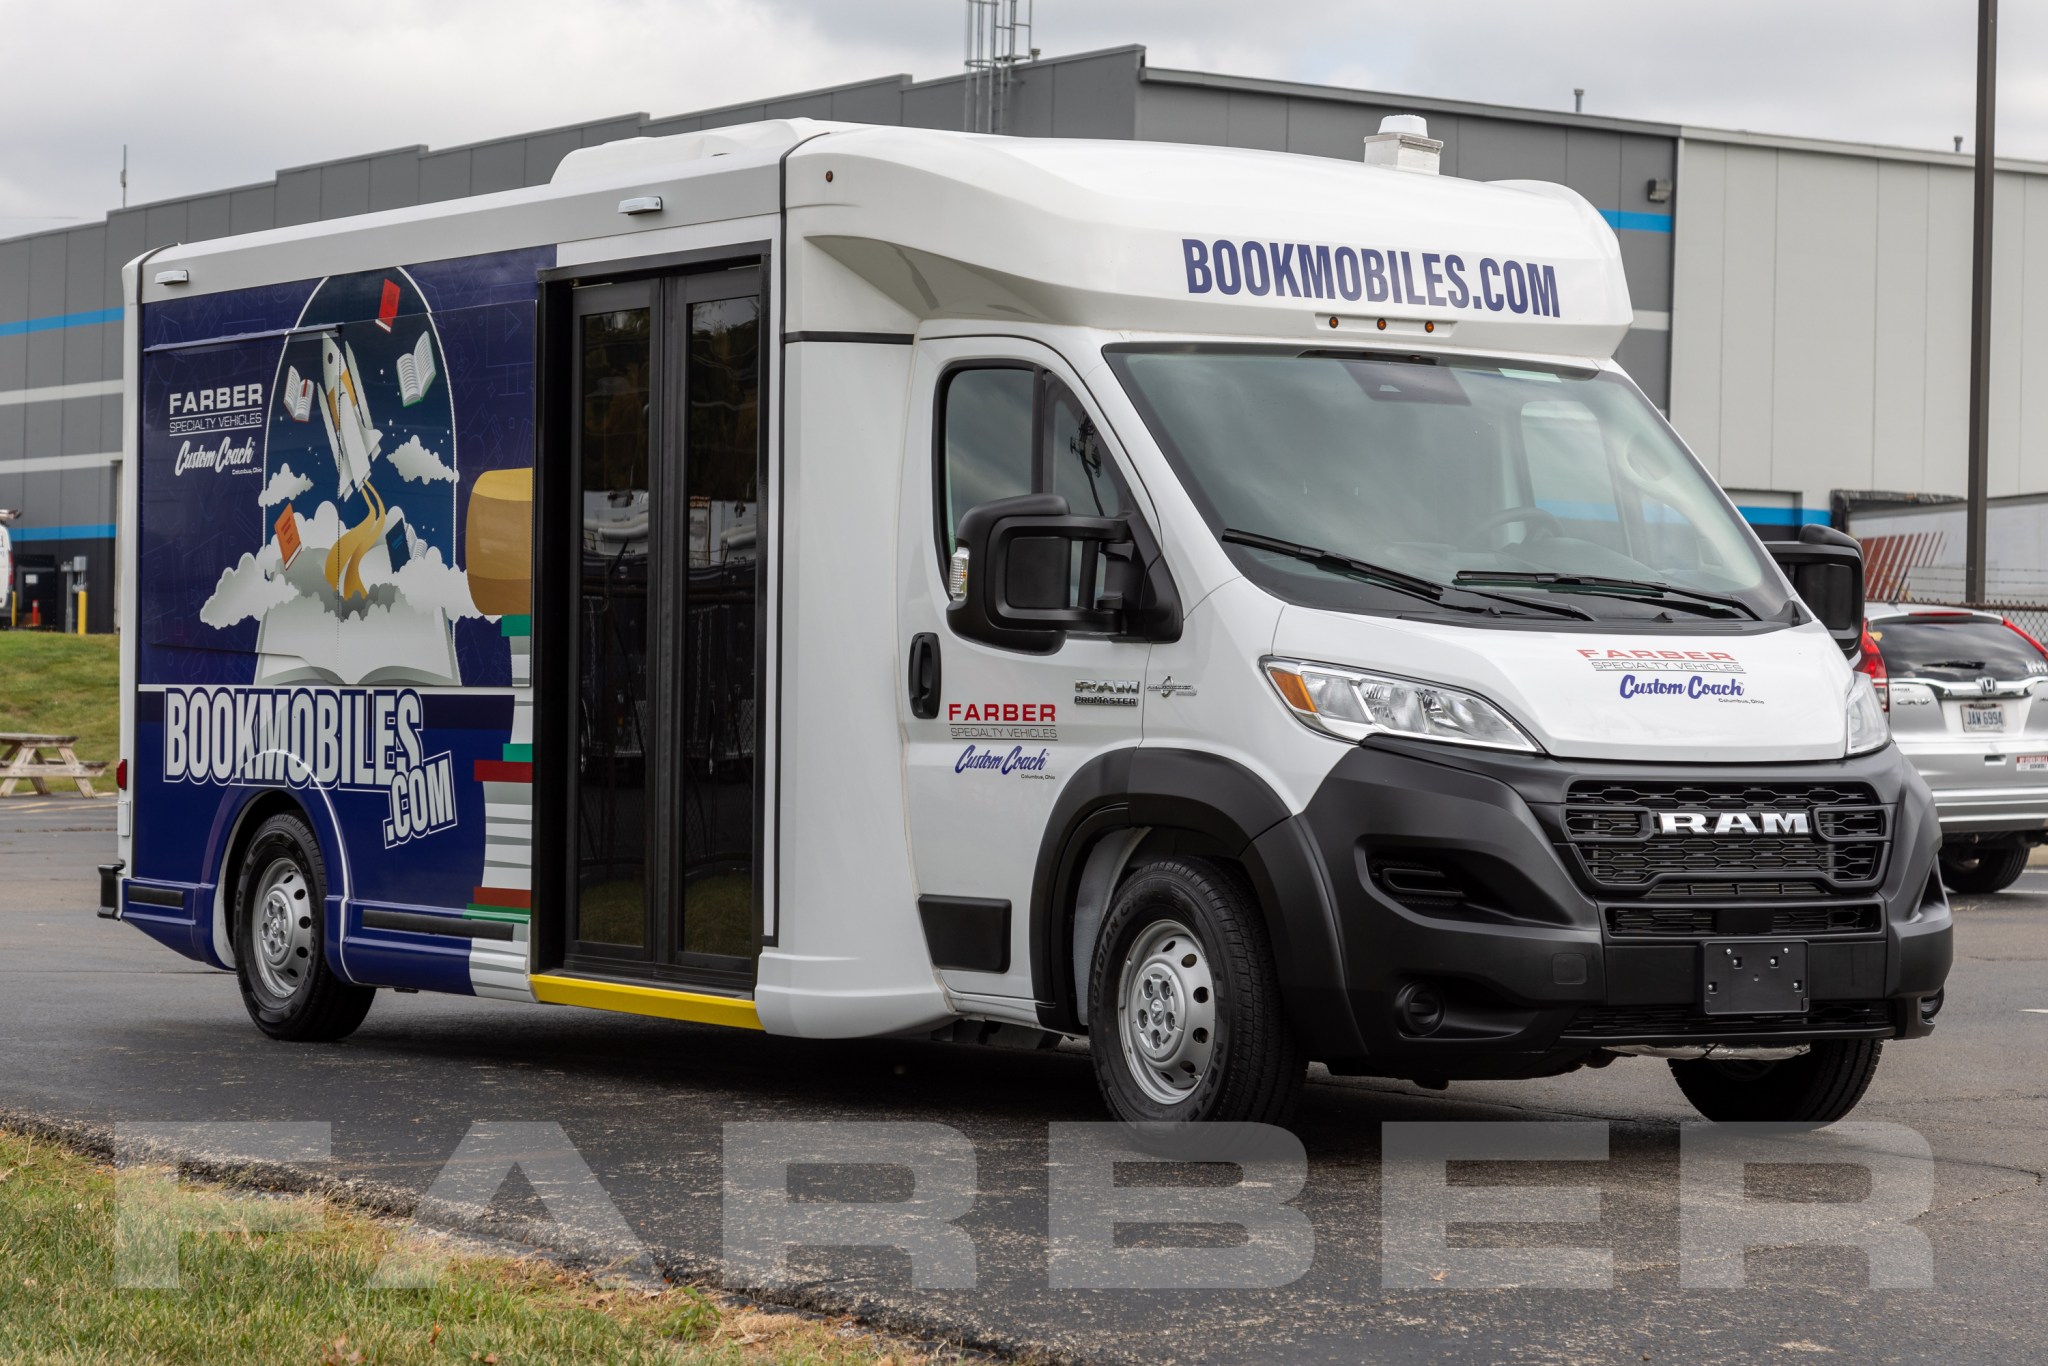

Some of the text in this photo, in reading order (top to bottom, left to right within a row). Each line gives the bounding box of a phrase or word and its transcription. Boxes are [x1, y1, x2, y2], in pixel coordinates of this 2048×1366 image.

[1182, 238, 1561, 318] BOOKMOBILES.COM
[169, 383, 263, 415] FARBER
[169, 412, 262, 433] SPECIALTY VEHICLES
[174, 436, 254, 477] Custom Coach
[1576, 649, 1736, 661] FARBER
[1591, 661, 1744, 672] SPECIALTY VEHICLES
[1075, 679, 1140, 694] RAM
[1619, 674, 1745, 700] Custom Coach
[948, 703, 1056, 722] FARBER
[165, 689, 422, 788] BOOKMOBILES
[950, 727, 1057, 739] SPECIALTY VEHICLES
[954, 744, 1047, 776] Custom Coach
[385, 755, 456, 846] .COM
[1658, 811, 1809, 835] RAM
